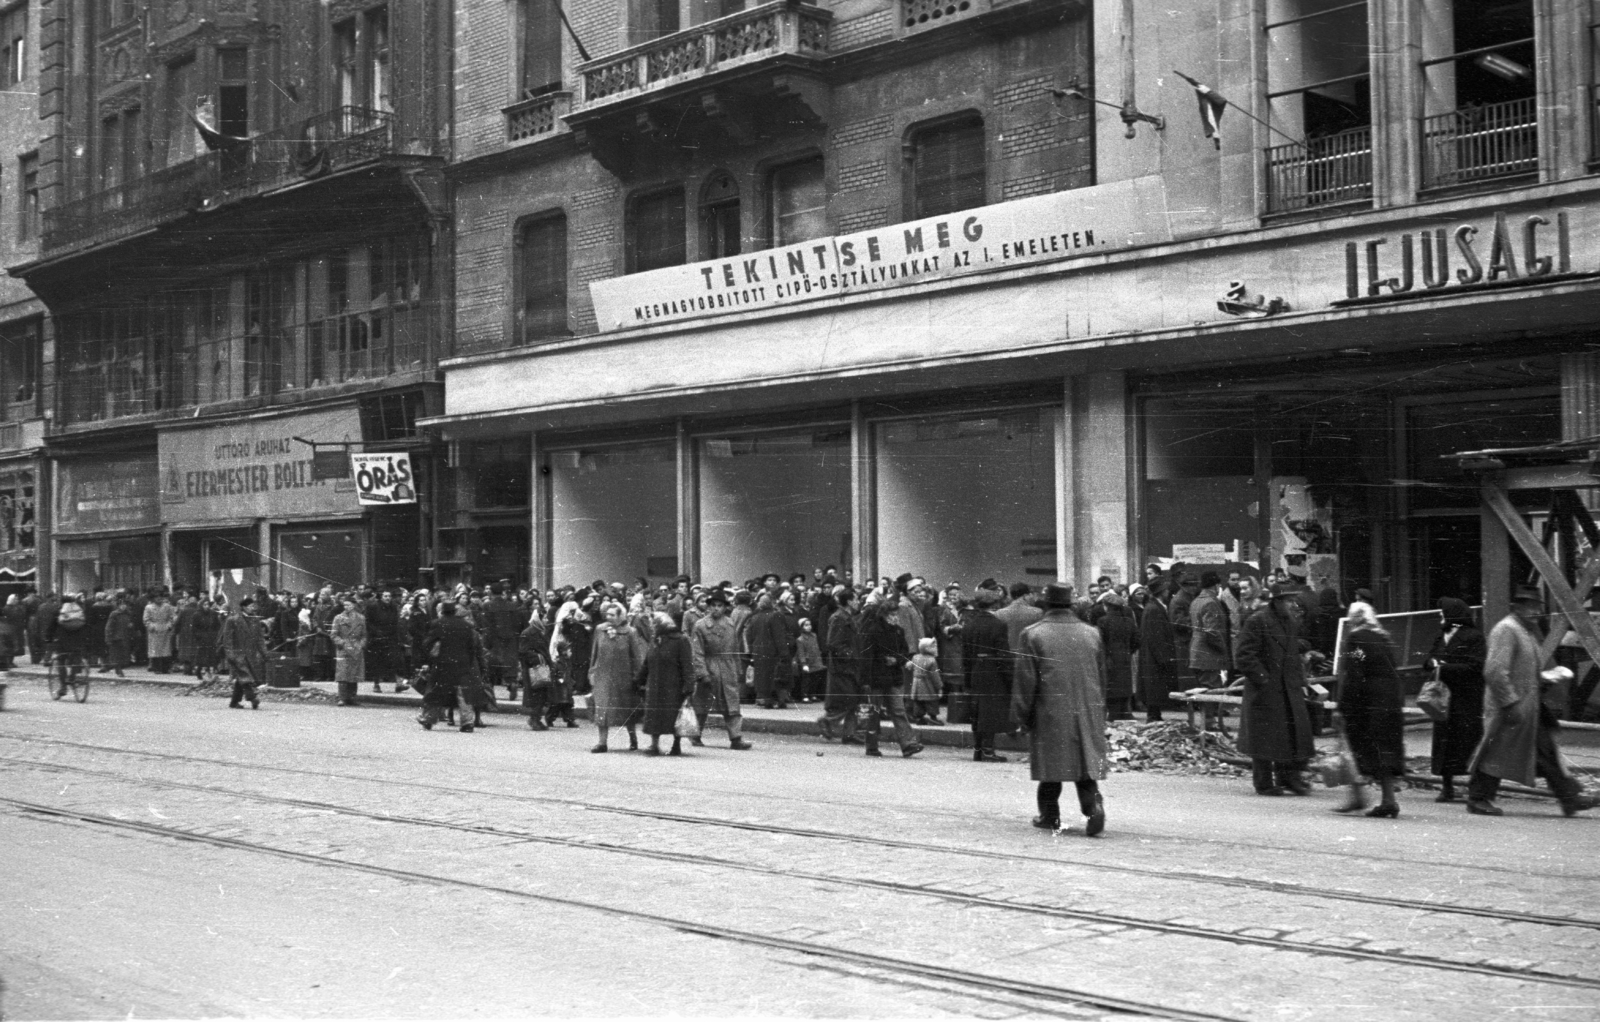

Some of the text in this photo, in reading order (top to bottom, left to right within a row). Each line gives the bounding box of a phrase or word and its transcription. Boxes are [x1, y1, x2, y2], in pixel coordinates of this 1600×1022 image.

[903, 216, 983, 255] MEG
[953, 250, 971, 269] AZ
[983, 247, 994, 263] I.
[1002, 229, 1106, 260] EMELETEN.
